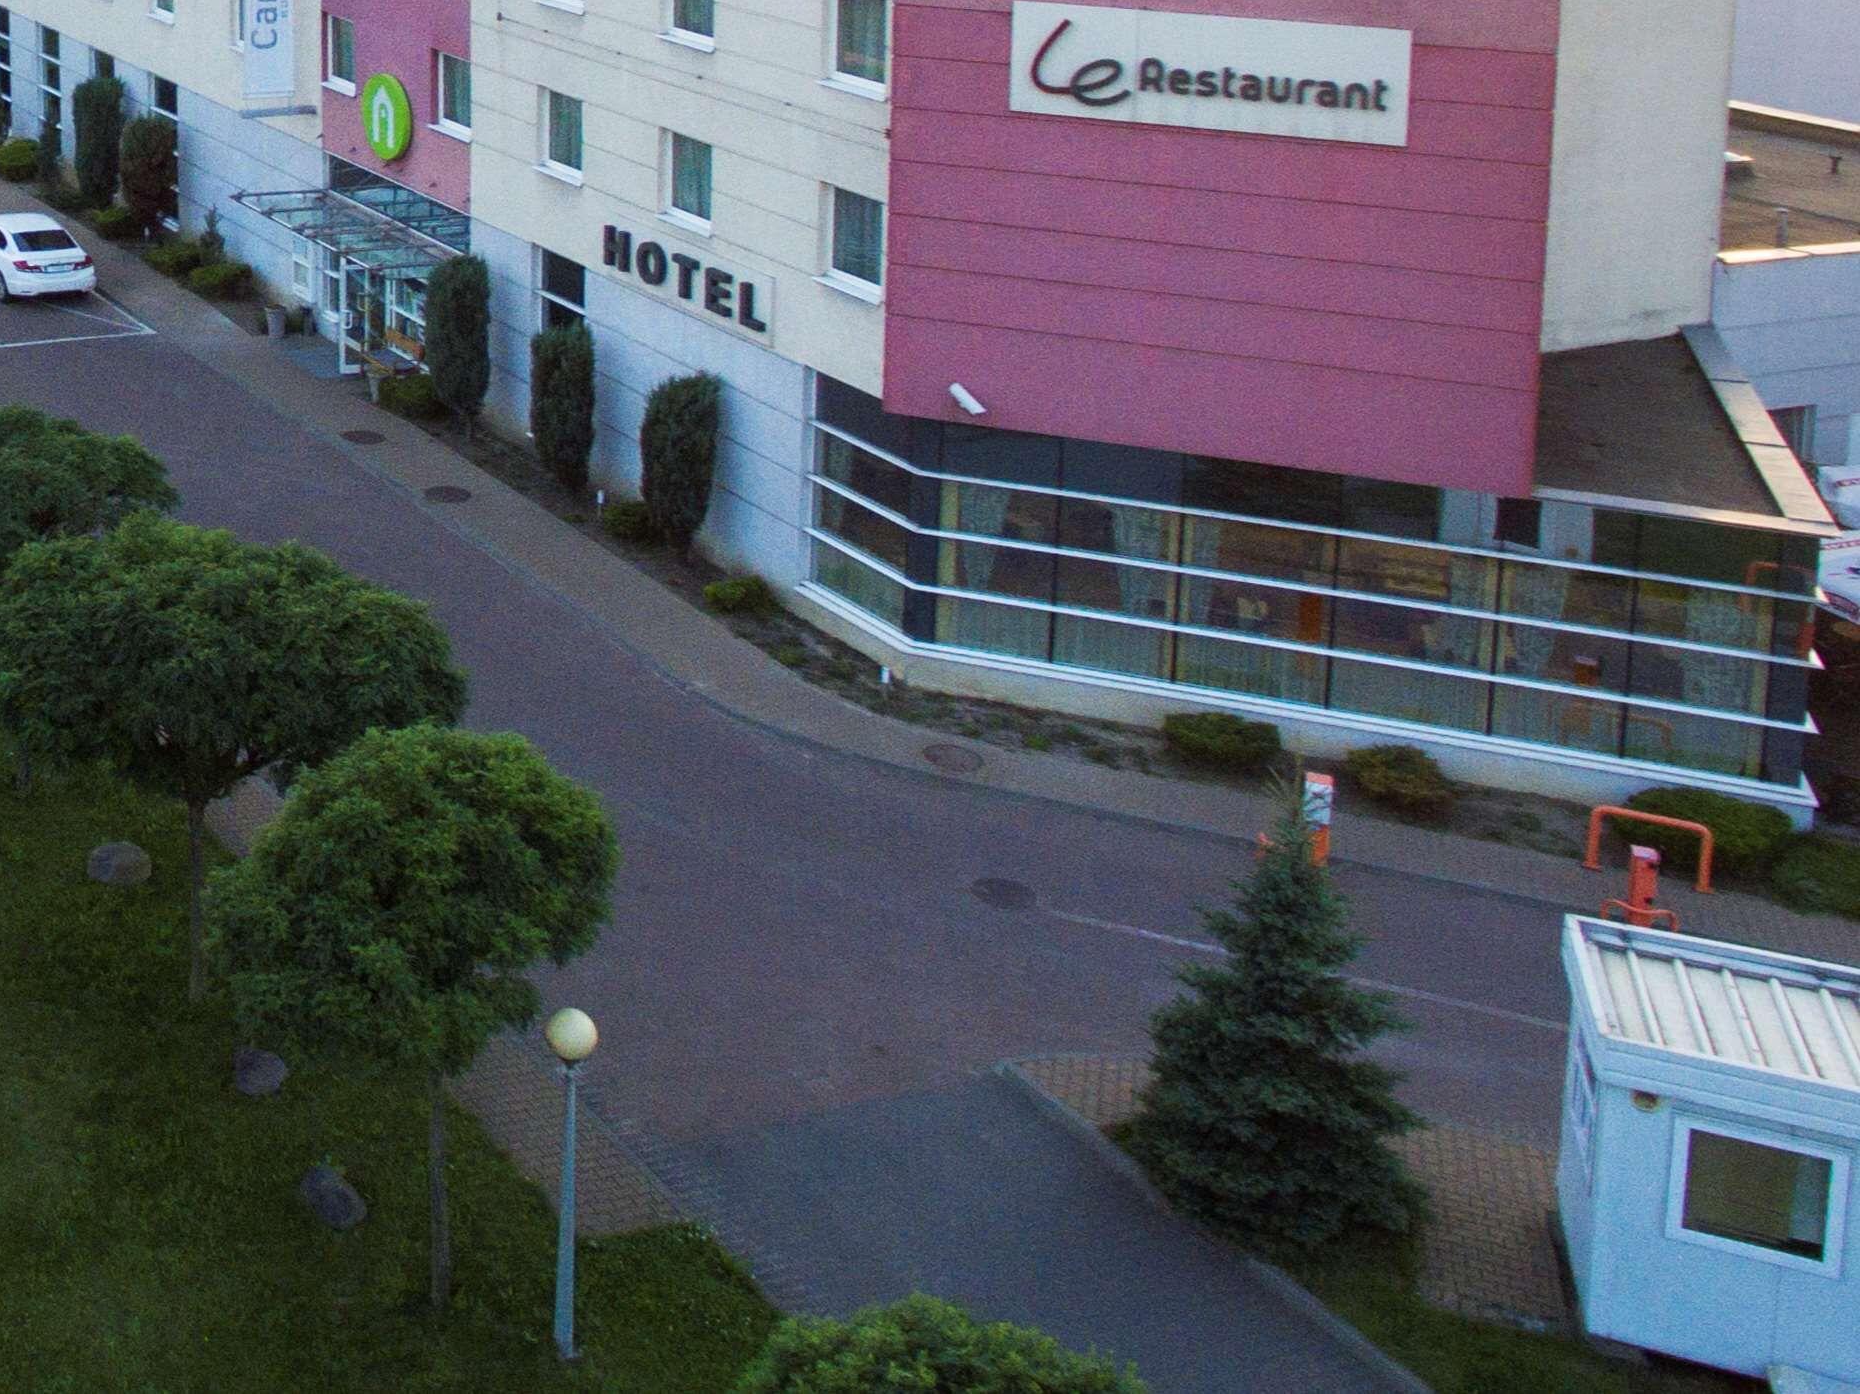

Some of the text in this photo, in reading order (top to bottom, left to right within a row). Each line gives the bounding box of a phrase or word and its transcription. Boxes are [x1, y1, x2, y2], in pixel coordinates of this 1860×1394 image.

[1029, 18, 1389, 112] Le Restaurant
[603, 224, 767, 333] HOTEL
